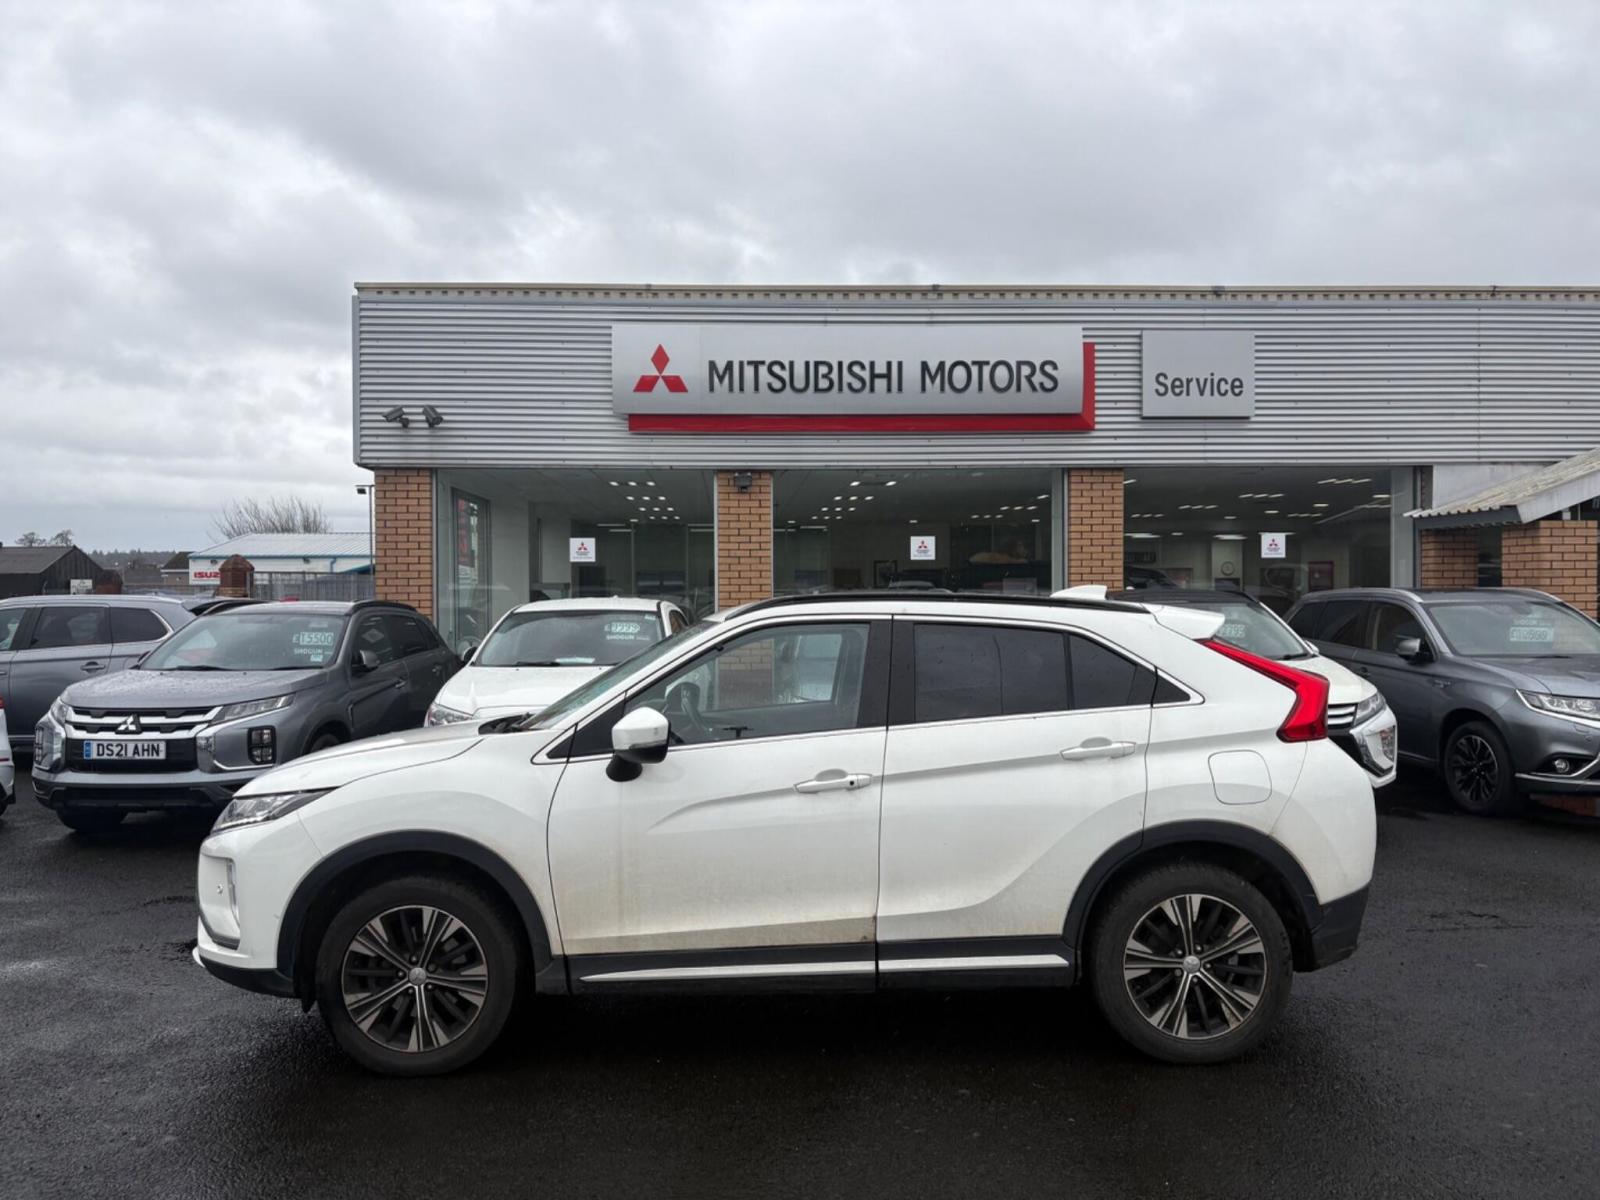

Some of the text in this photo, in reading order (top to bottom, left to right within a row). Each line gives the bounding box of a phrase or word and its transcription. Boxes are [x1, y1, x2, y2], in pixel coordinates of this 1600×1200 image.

[708, 360, 1059, 393] MITSUBISHI MOTORS
[1154, 372, 1244, 397] Service
[194, 571, 221, 579] ISUZ
[96, 743, 160, 757] DS21 AHN
